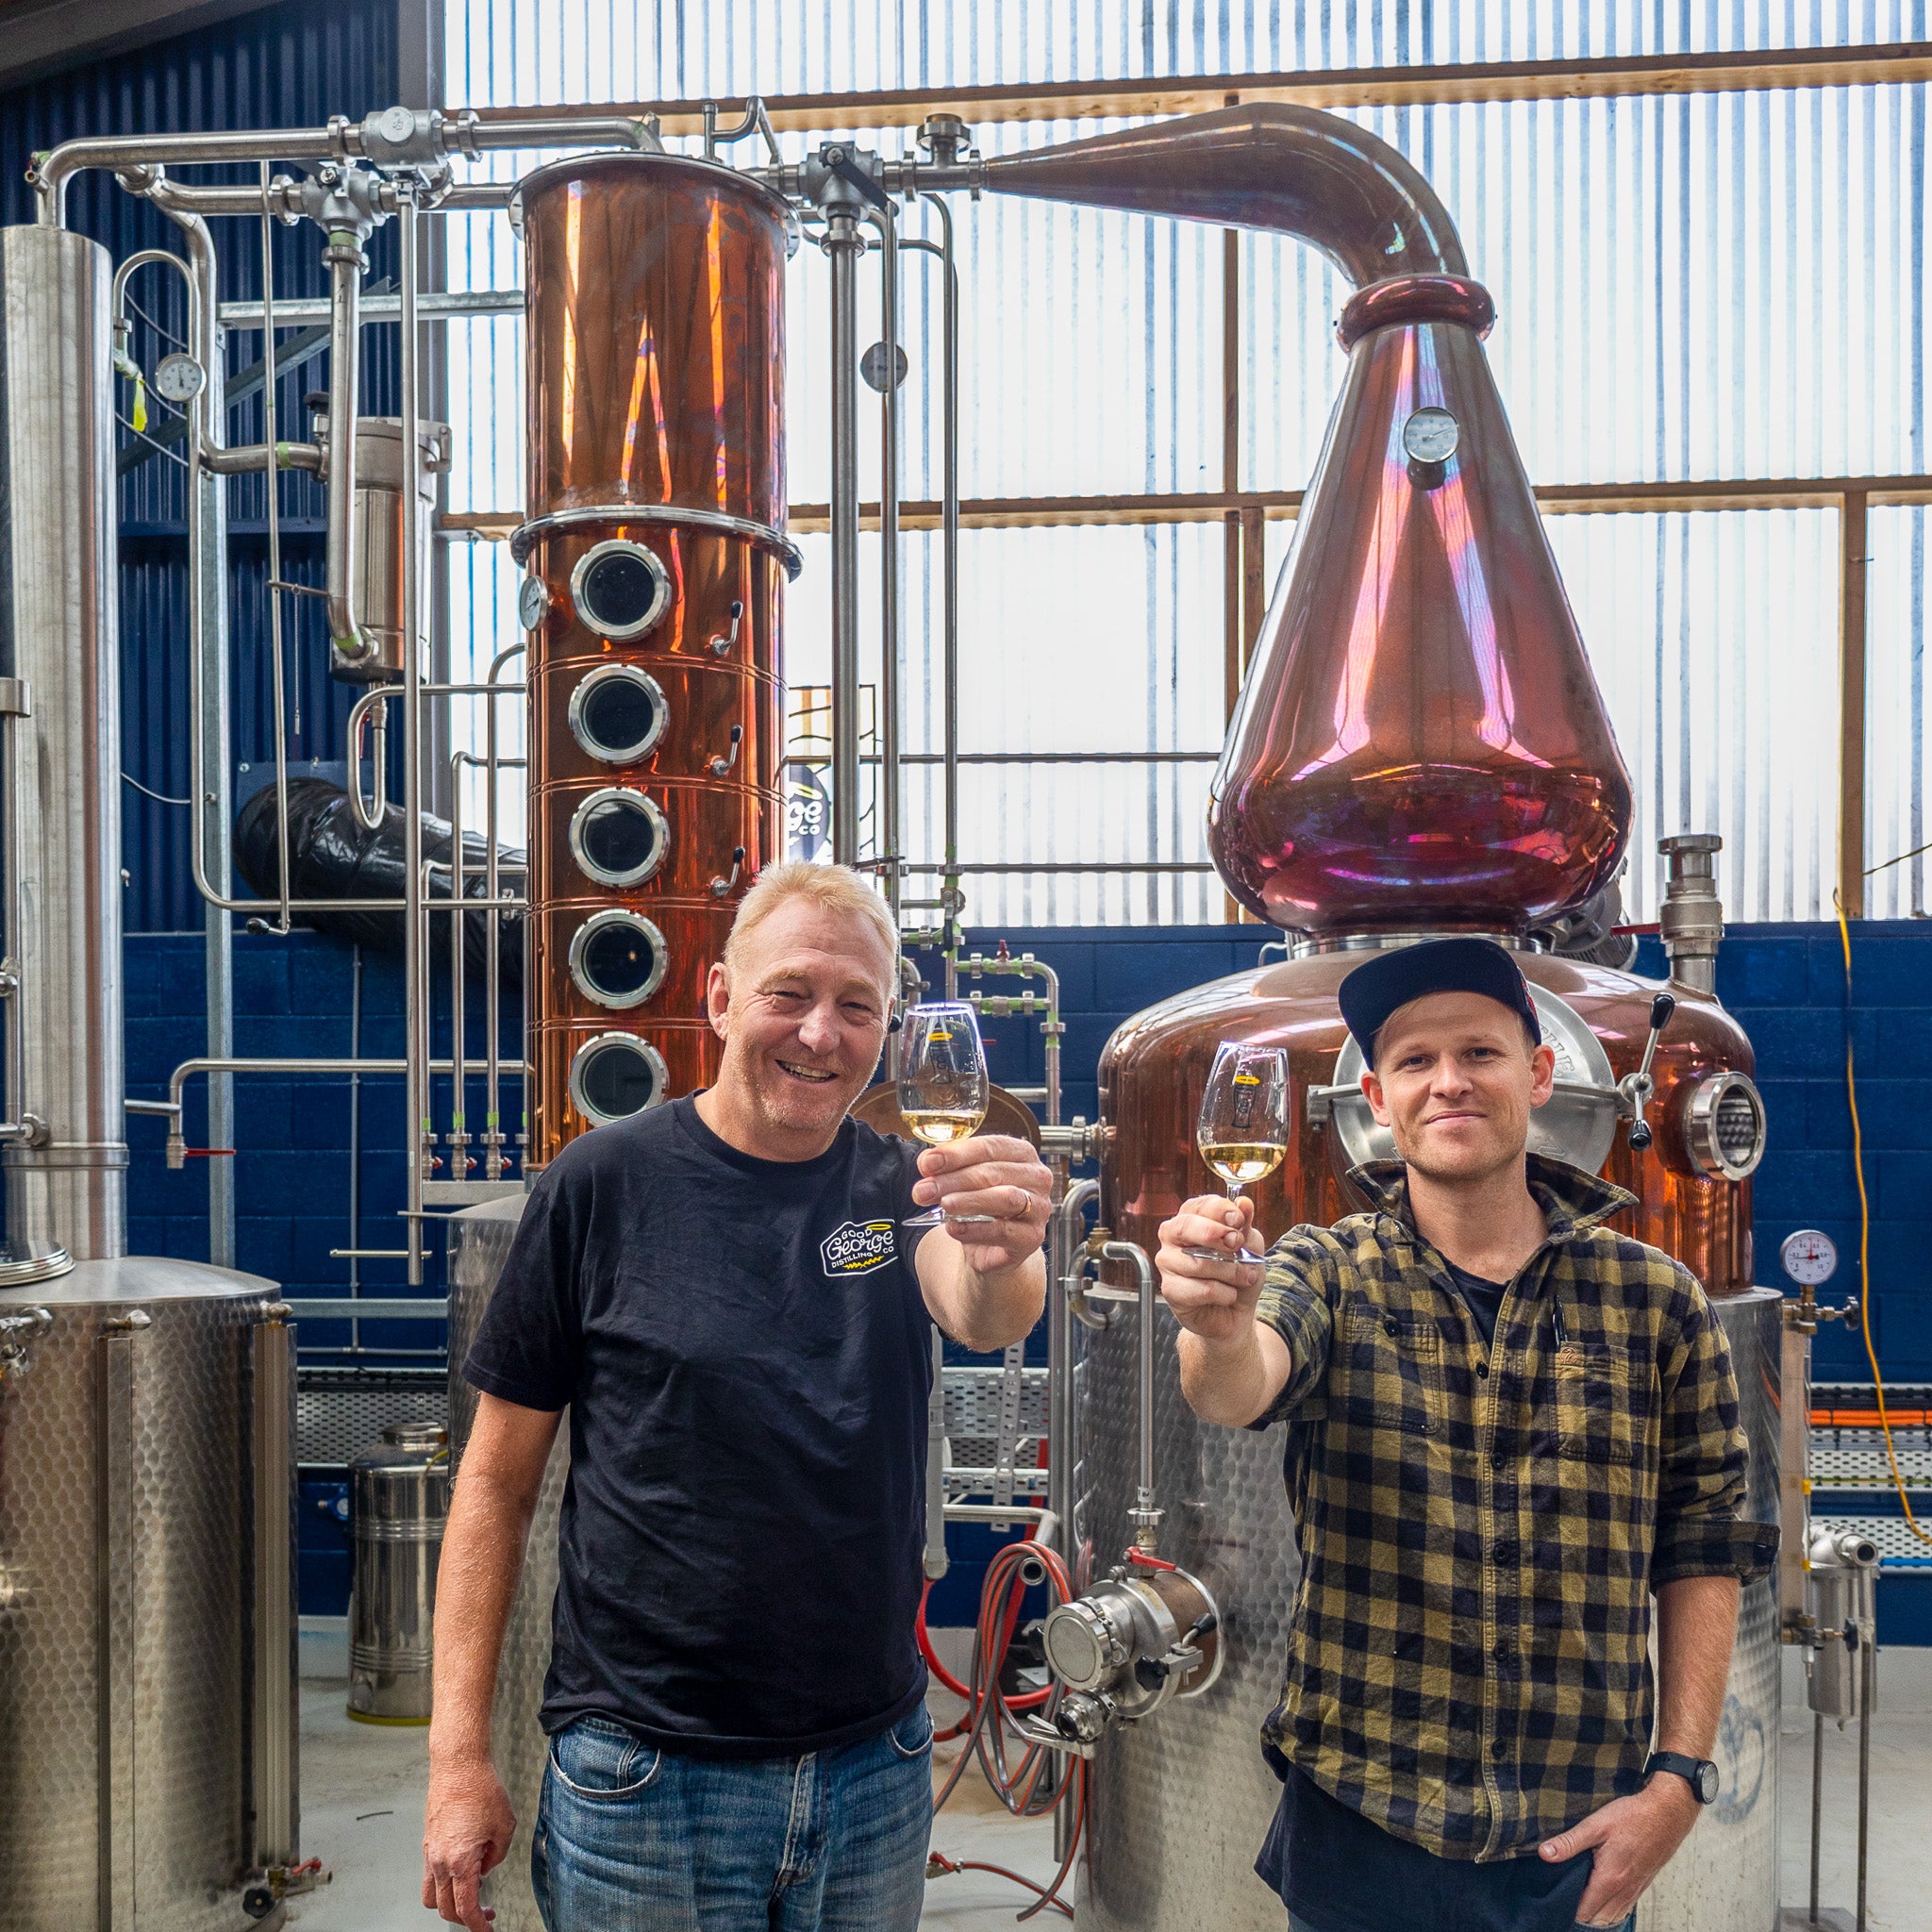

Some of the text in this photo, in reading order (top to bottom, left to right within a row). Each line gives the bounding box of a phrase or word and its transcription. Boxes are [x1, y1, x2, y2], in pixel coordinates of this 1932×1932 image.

[841, 1228, 873, 1240] GOOD
[826, 1230, 894, 1260] George
[831, 1252, 874, 1268] DISTILLING
